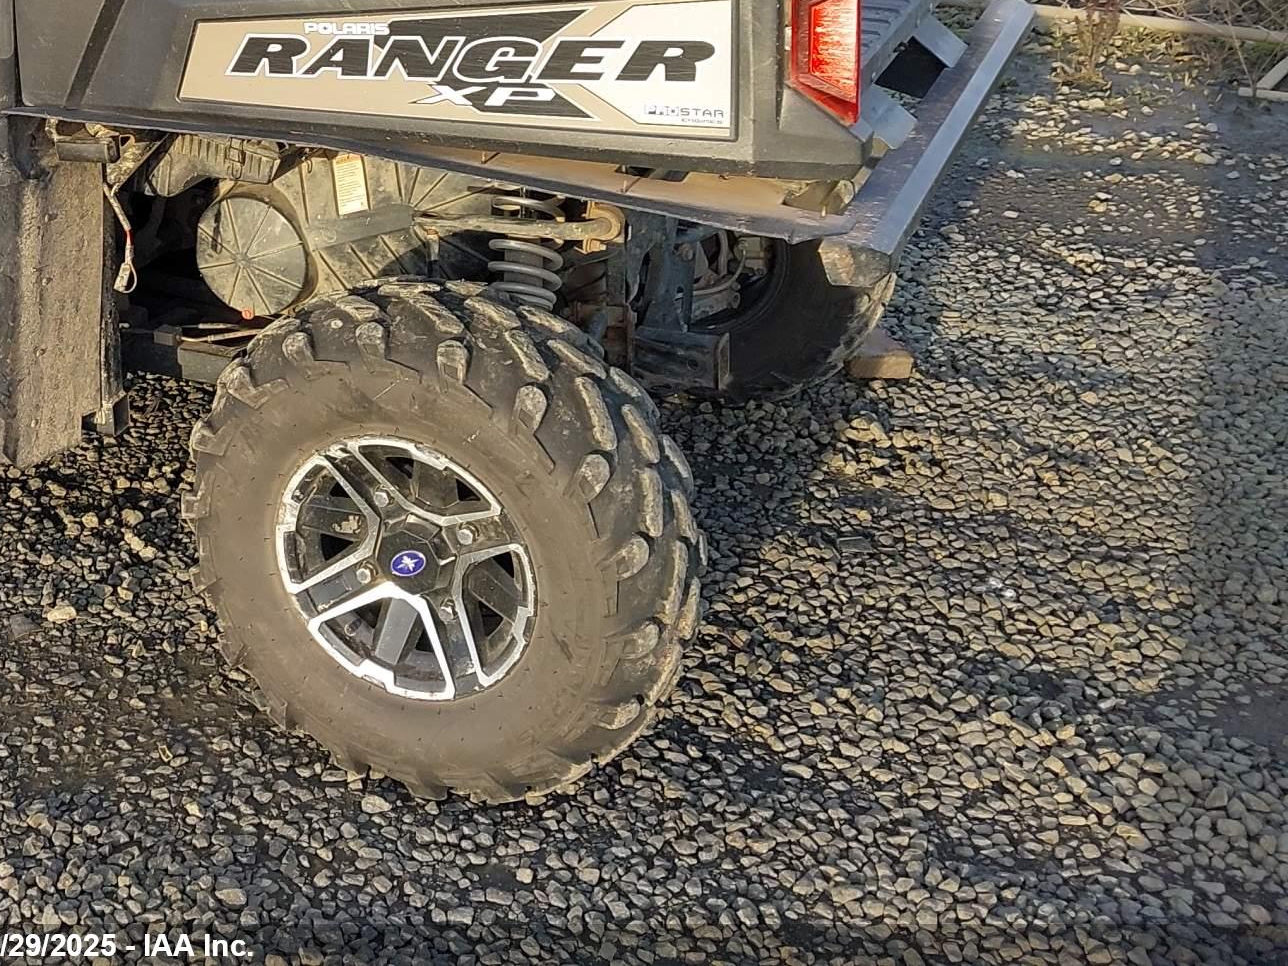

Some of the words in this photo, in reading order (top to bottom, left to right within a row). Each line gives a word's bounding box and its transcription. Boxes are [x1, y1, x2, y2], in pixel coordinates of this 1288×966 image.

[303, 21, 391, 35] POLARIS
[225, 34, 715, 84] RANGER
[408, 84, 556, 107] XP
